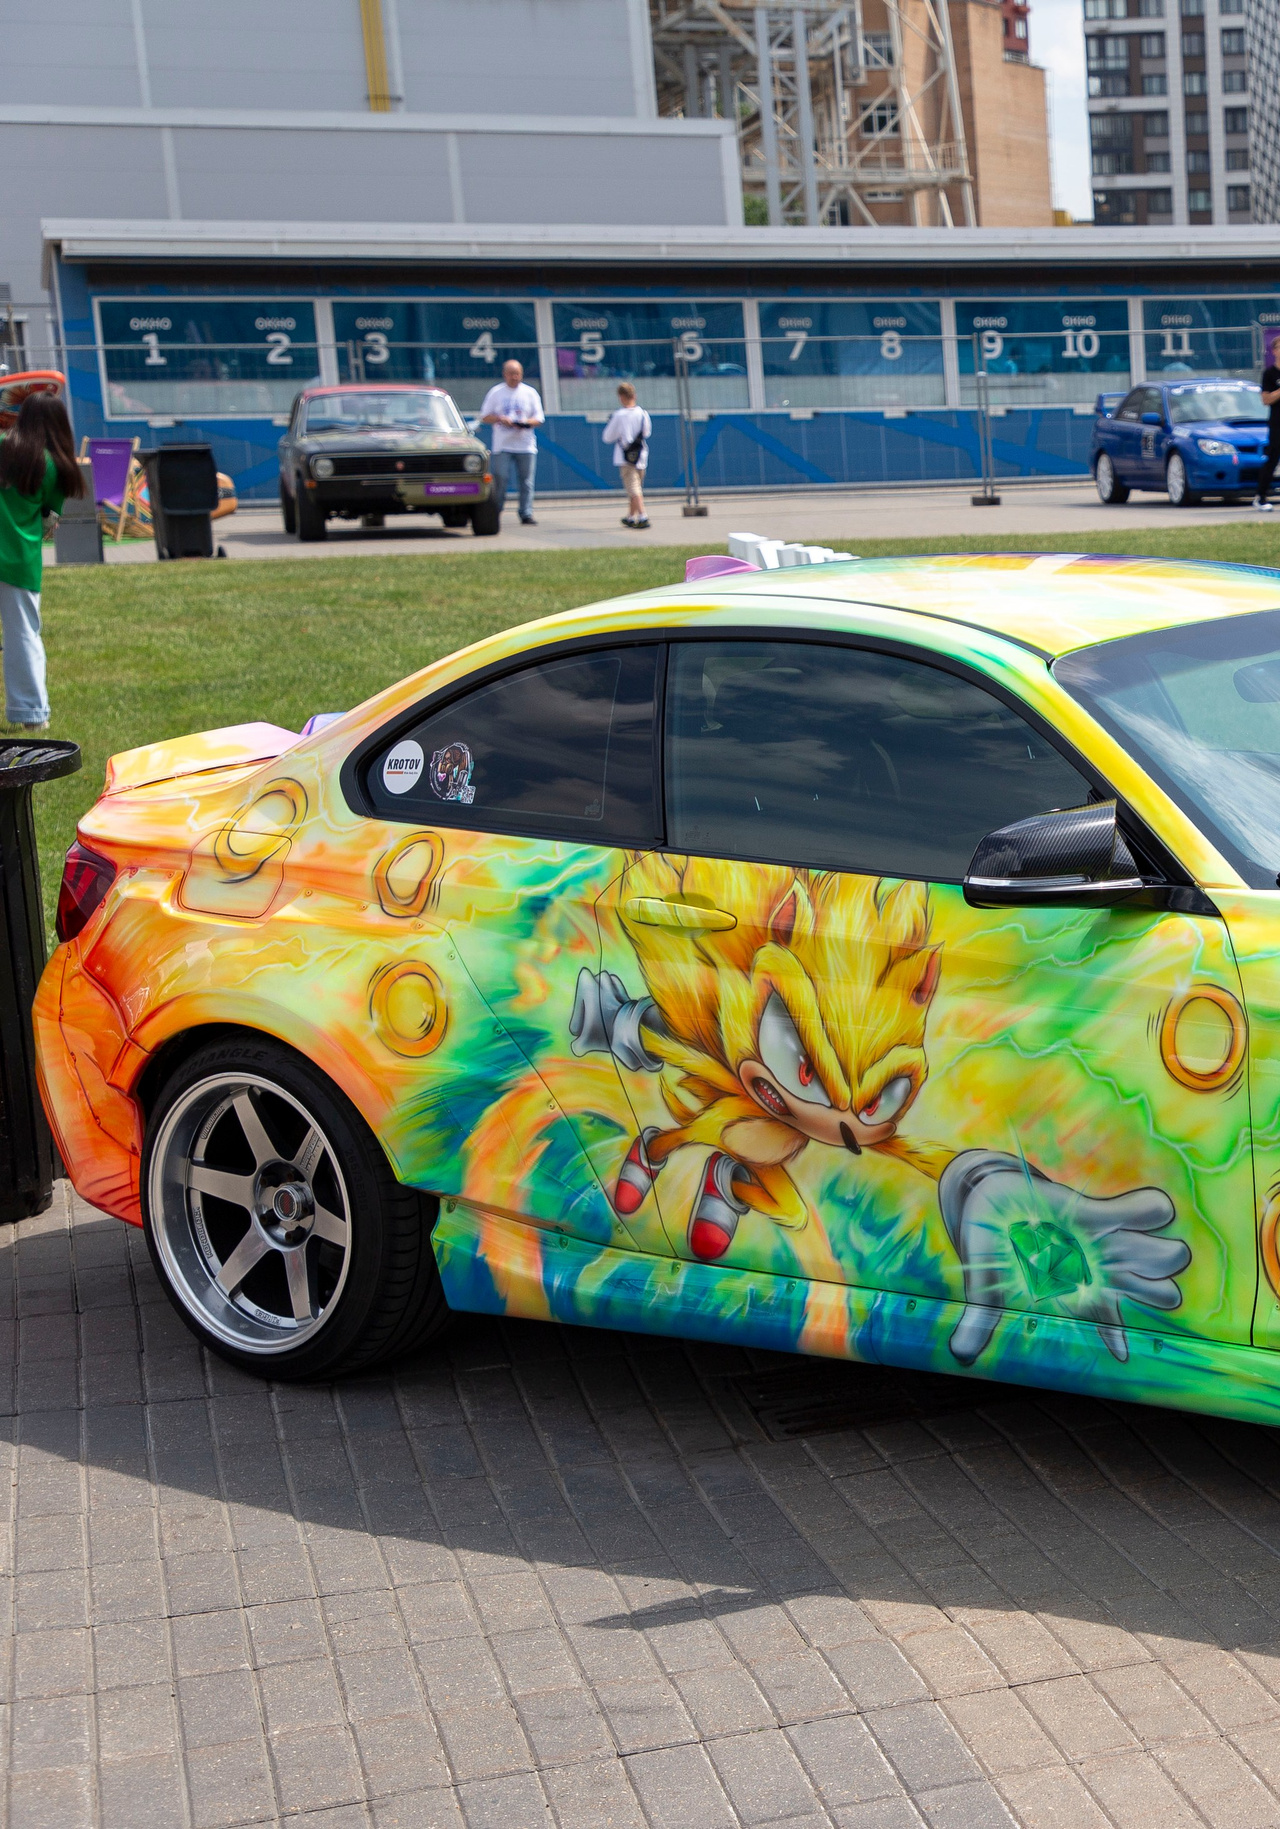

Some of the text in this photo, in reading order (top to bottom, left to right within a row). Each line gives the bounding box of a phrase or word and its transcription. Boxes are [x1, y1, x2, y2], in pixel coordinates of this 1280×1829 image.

[141, 333, 168, 365] 1
[264, 332, 293, 365] 2
[364, 332, 391, 364] 3
[470, 331, 498, 363] 4
[580, 331, 606, 363] 5
[678, 331, 703, 362] 6
[784, 330, 808, 361] 7
[879, 330, 903, 360] 8
[980, 329, 1004, 359] 9
[1061, 328, 1101, 358] 10
[1160, 328, 1195, 356] 11
[387, 758, 421, 770] KROTOV
